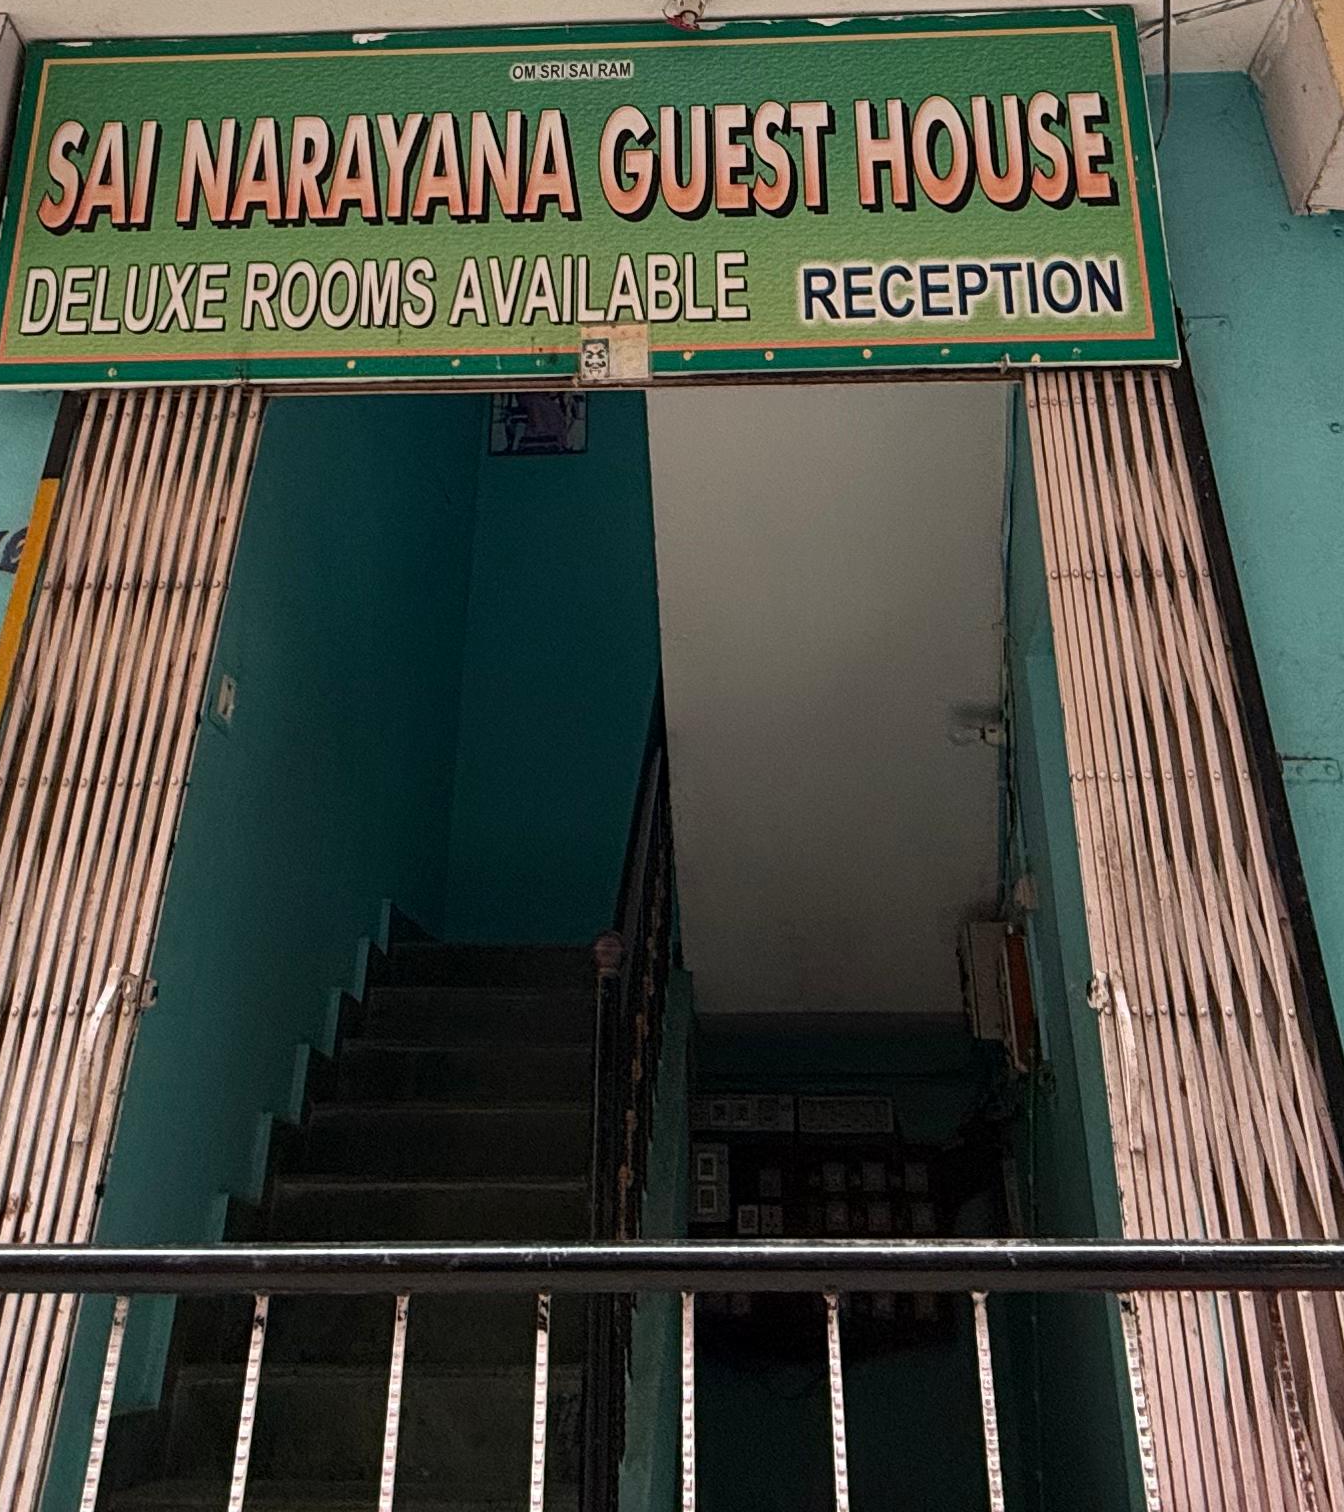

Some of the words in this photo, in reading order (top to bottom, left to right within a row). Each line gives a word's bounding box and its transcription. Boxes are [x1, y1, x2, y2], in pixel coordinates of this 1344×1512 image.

[512, 65, 536, 80] OM
[540, 64, 565, 79] SRI
[568, 63, 594, 78] SAI
[598, 62, 631, 77] RAM
[37, 120, 162, 234] SAI
[176, 109, 581, 227] NARAYANA
[599, 100, 836, 221] GUEST
[854, 91, 1120, 210] HOUSE
[19, 262, 230, 336] DELUXE
[242, 257, 436, 330] ROOMS
[448, 251, 750, 327] AVAILABLE
[803, 260, 1122, 320] RECEPTION
